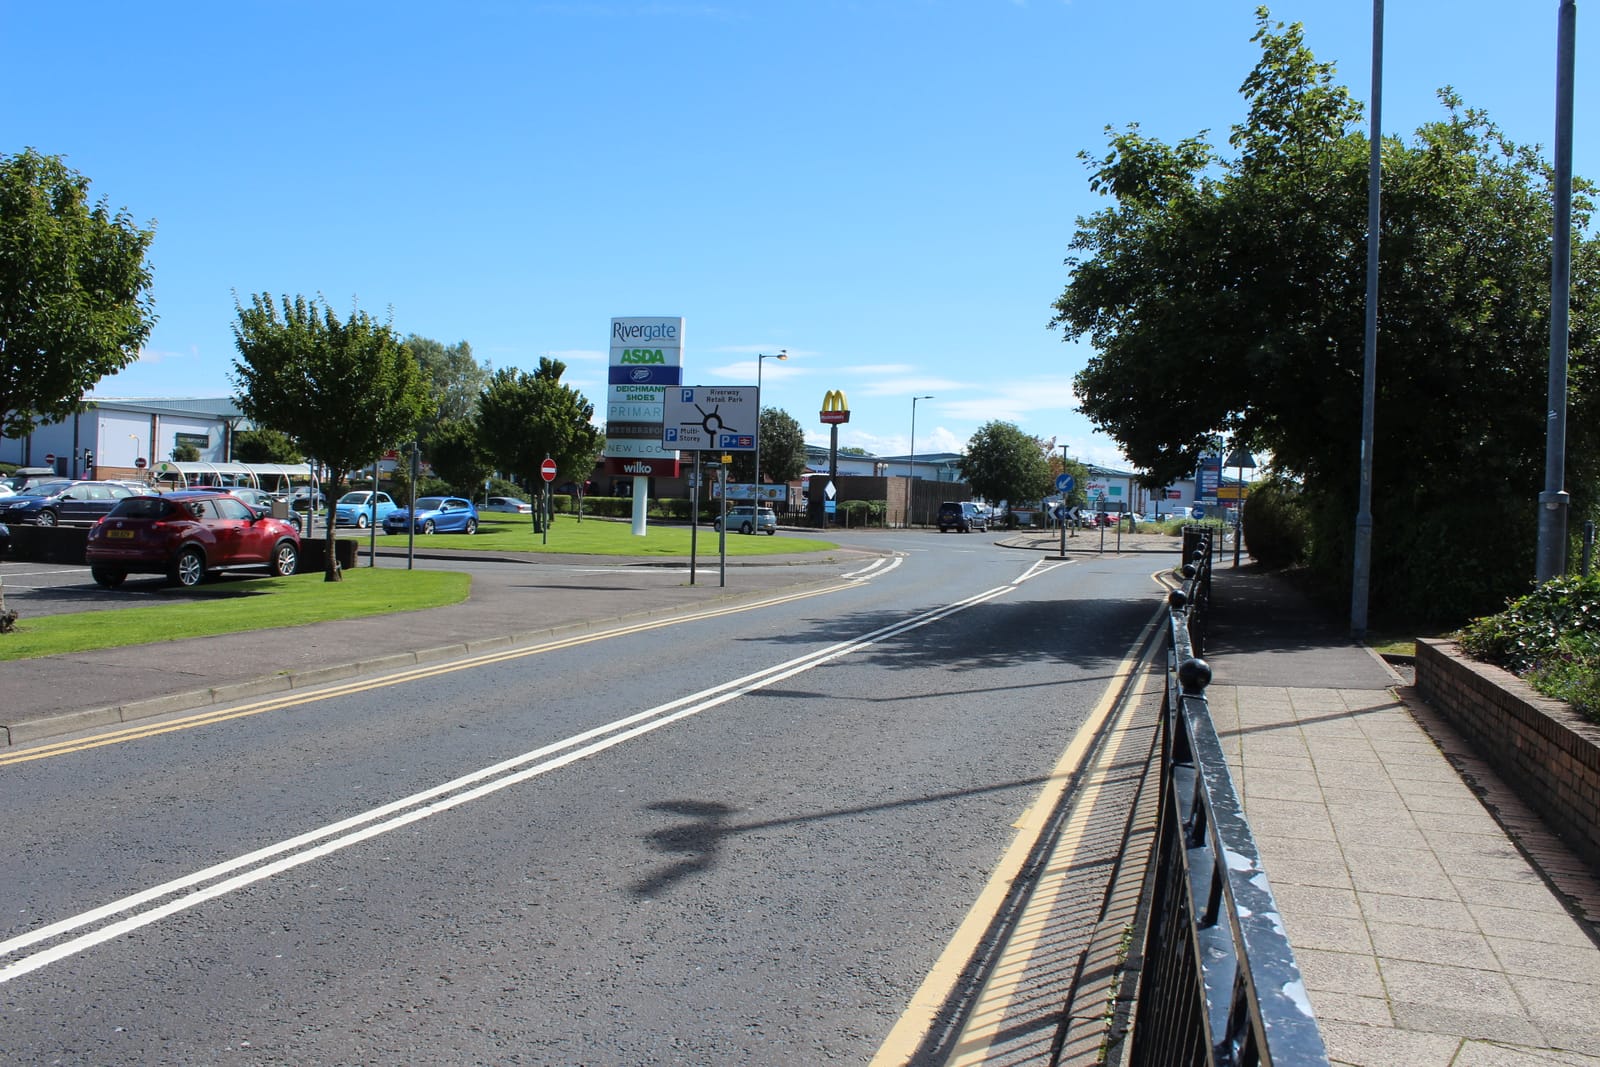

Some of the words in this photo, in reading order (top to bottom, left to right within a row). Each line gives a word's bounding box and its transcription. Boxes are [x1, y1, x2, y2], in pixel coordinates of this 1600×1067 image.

[613, 322, 676, 341] Rivergate
[620, 349, 665, 364] ASDA
[683, 390, 692, 402] P
[610, 407, 661, 417] PRIMAR
[667, 430, 676, 441] P
[721, 435, 730, 447] P
[623, 461, 652, 474] wilko
